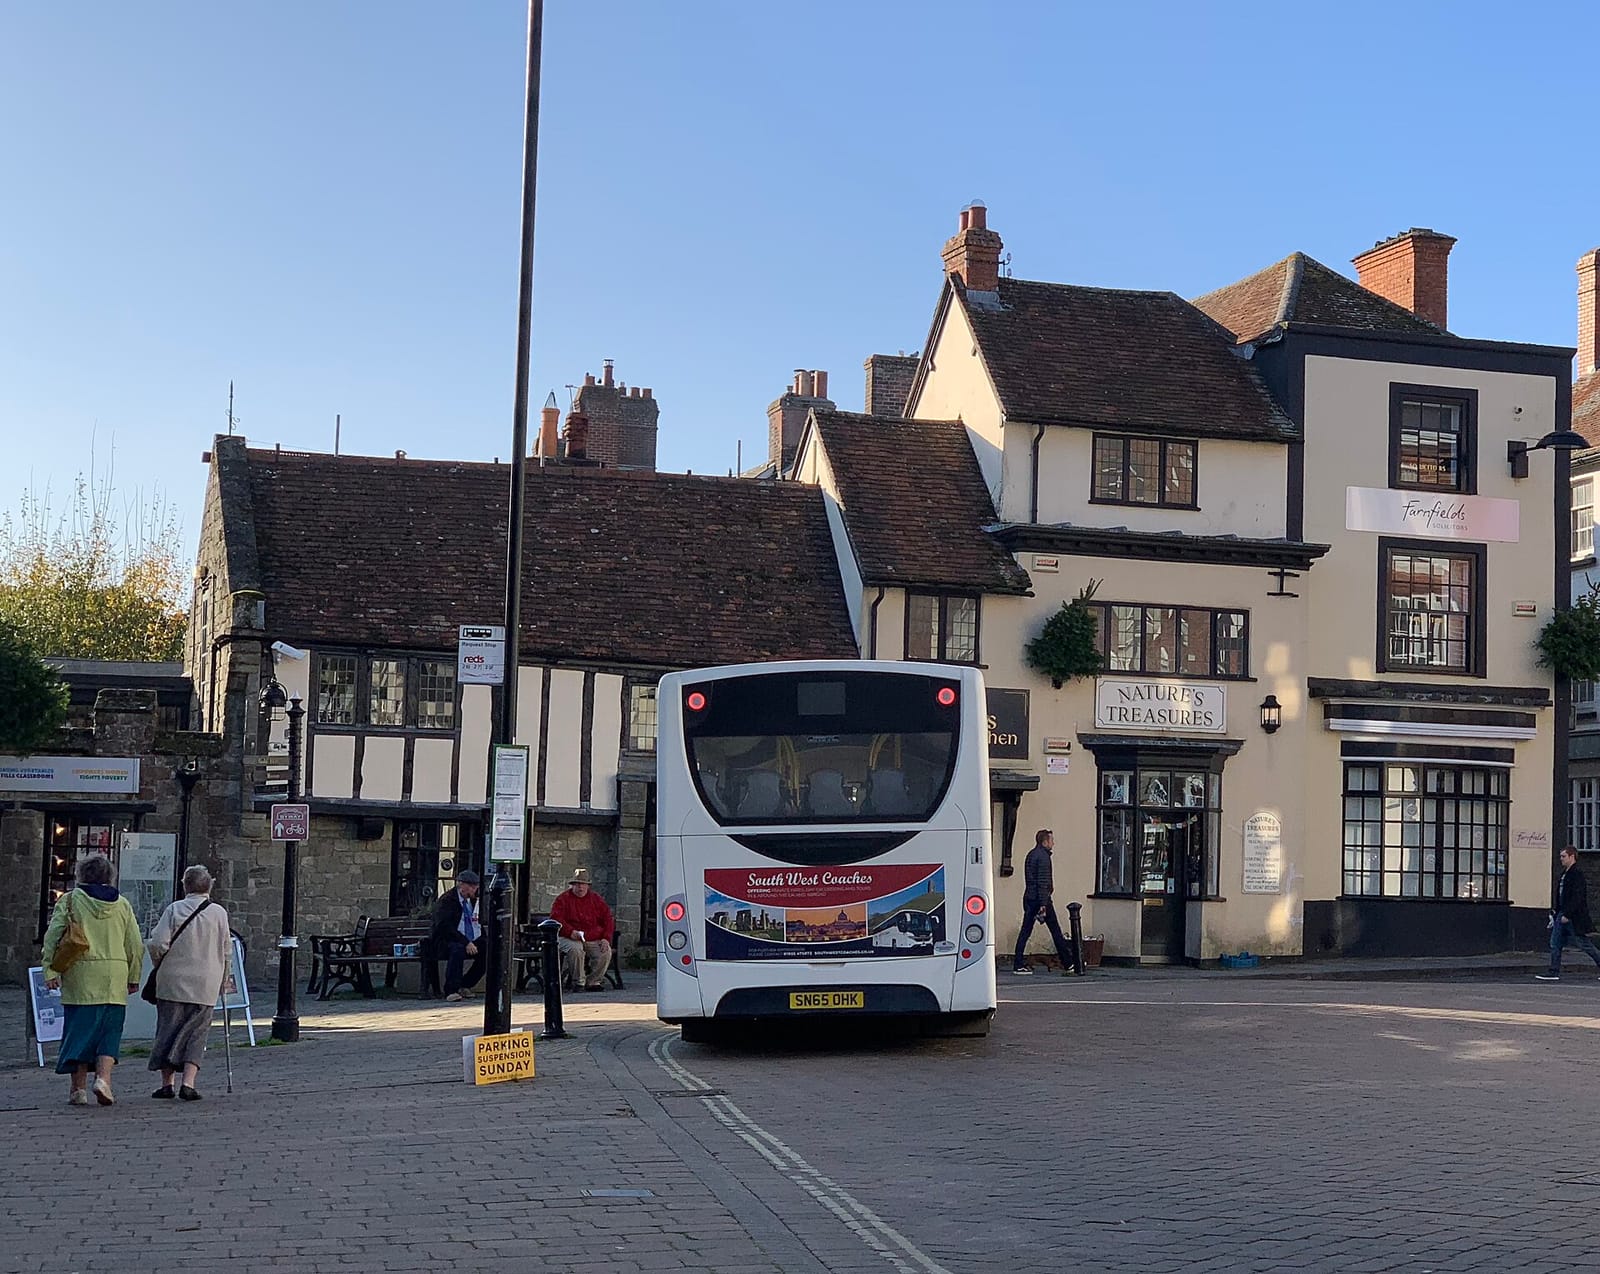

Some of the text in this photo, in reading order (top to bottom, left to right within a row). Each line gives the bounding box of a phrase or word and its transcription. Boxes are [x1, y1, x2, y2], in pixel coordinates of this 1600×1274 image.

[1402, 500, 1465, 528] Farnfields
[1432, 523, 1468, 531] SOLICITORS
[464, 655, 484, 664] reds
[1117, 684, 1205, 706] NATURE'S
[1106, 705, 1213, 727] TREASURES
[987, 731, 1018, 746] hen
[747, 871, 873, 886] South West Coaches
[796, 993, 858, 1007] SN65 OHK
[478, 1037, 530, 1054] PARKING
[477, 1050, 531, 1064] SUSPENSION
[479, 1060, 530, 1077] SUNDAY
